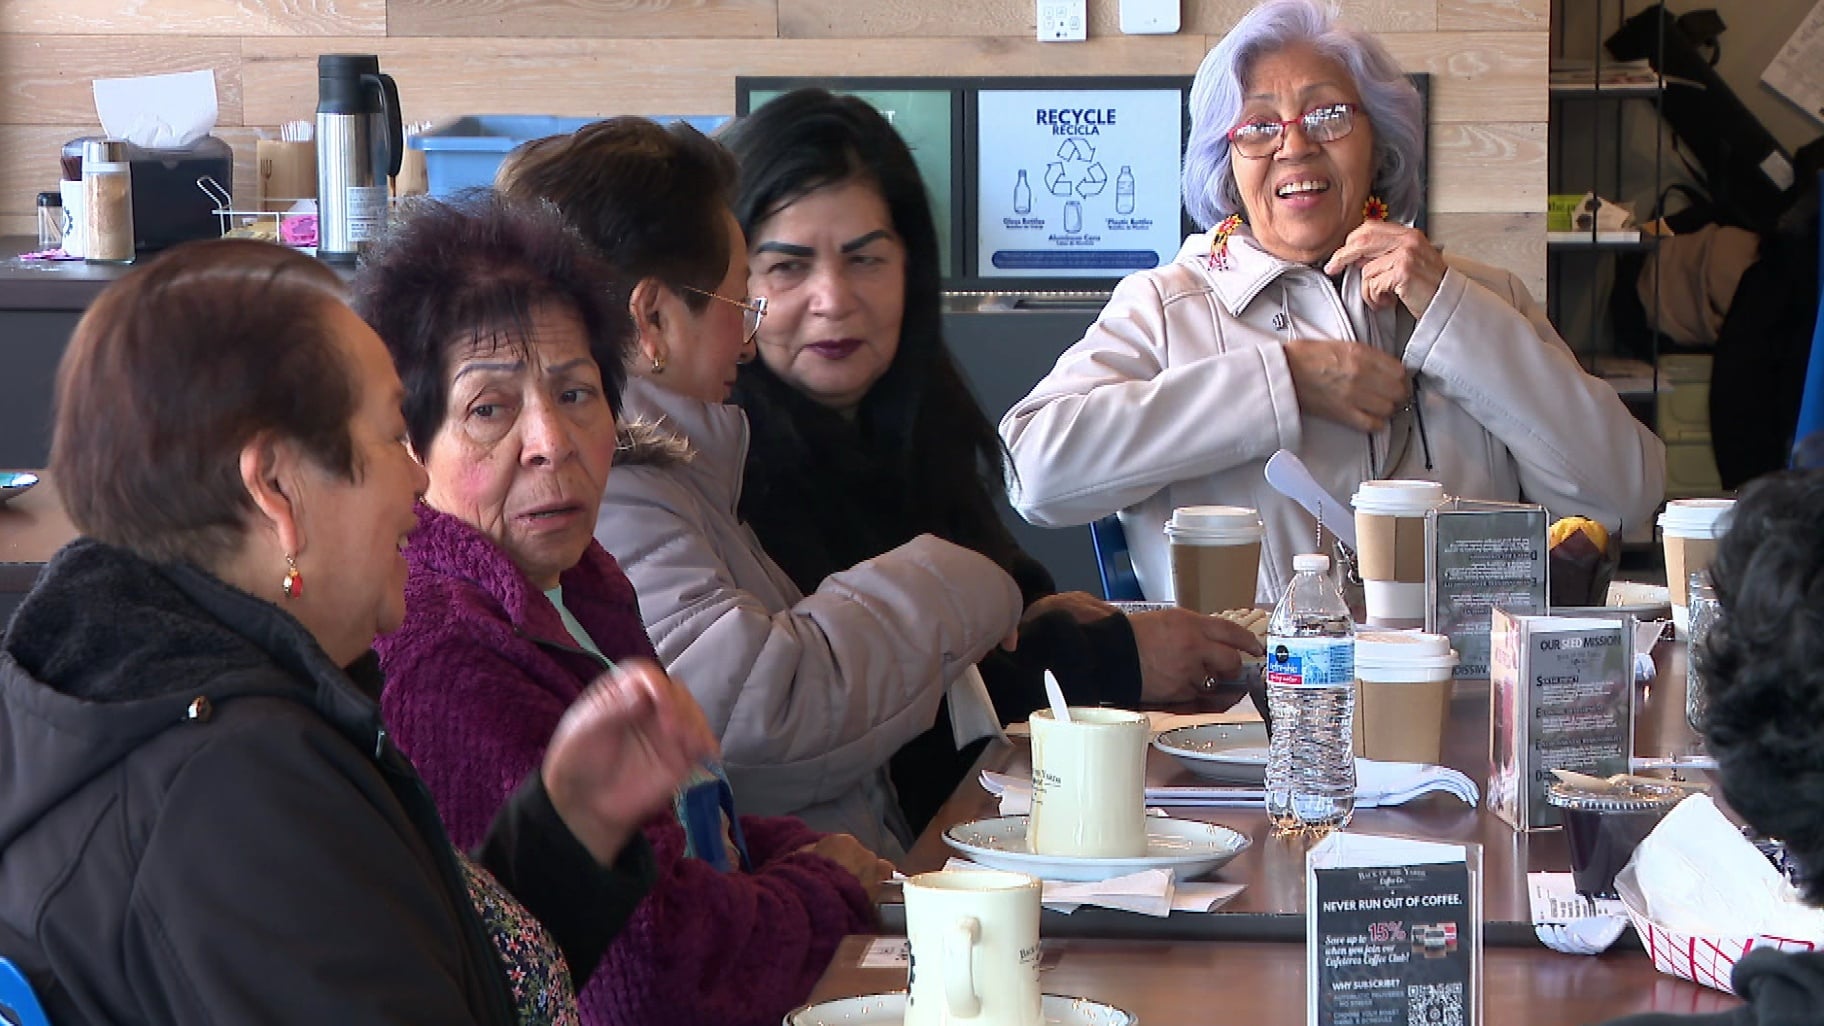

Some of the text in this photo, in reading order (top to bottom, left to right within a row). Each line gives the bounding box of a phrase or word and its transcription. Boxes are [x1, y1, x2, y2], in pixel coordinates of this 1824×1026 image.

[1036, 109, 1117, 125] RECYCLE
[1052, 125, 1100, 136] RECICLA
[1022, 218, 1046, 226] Bottles
[1130, 218, 1153, 226] Bottles
[1540, 634, 1622, 651] OUR SEED MISSION
[1323, 894, 1463, 913] NEVER RUN OUT OF COFFEE.
[1325, 921, 1407, 946] Save up to 15%
[1325, 945, 1347, 956] when
[1348, 947, 1363, 958] you
[1363, 944, 1381, 957] join
[1332, 979, 1400, 991] WHY SUBSCRIBE?
